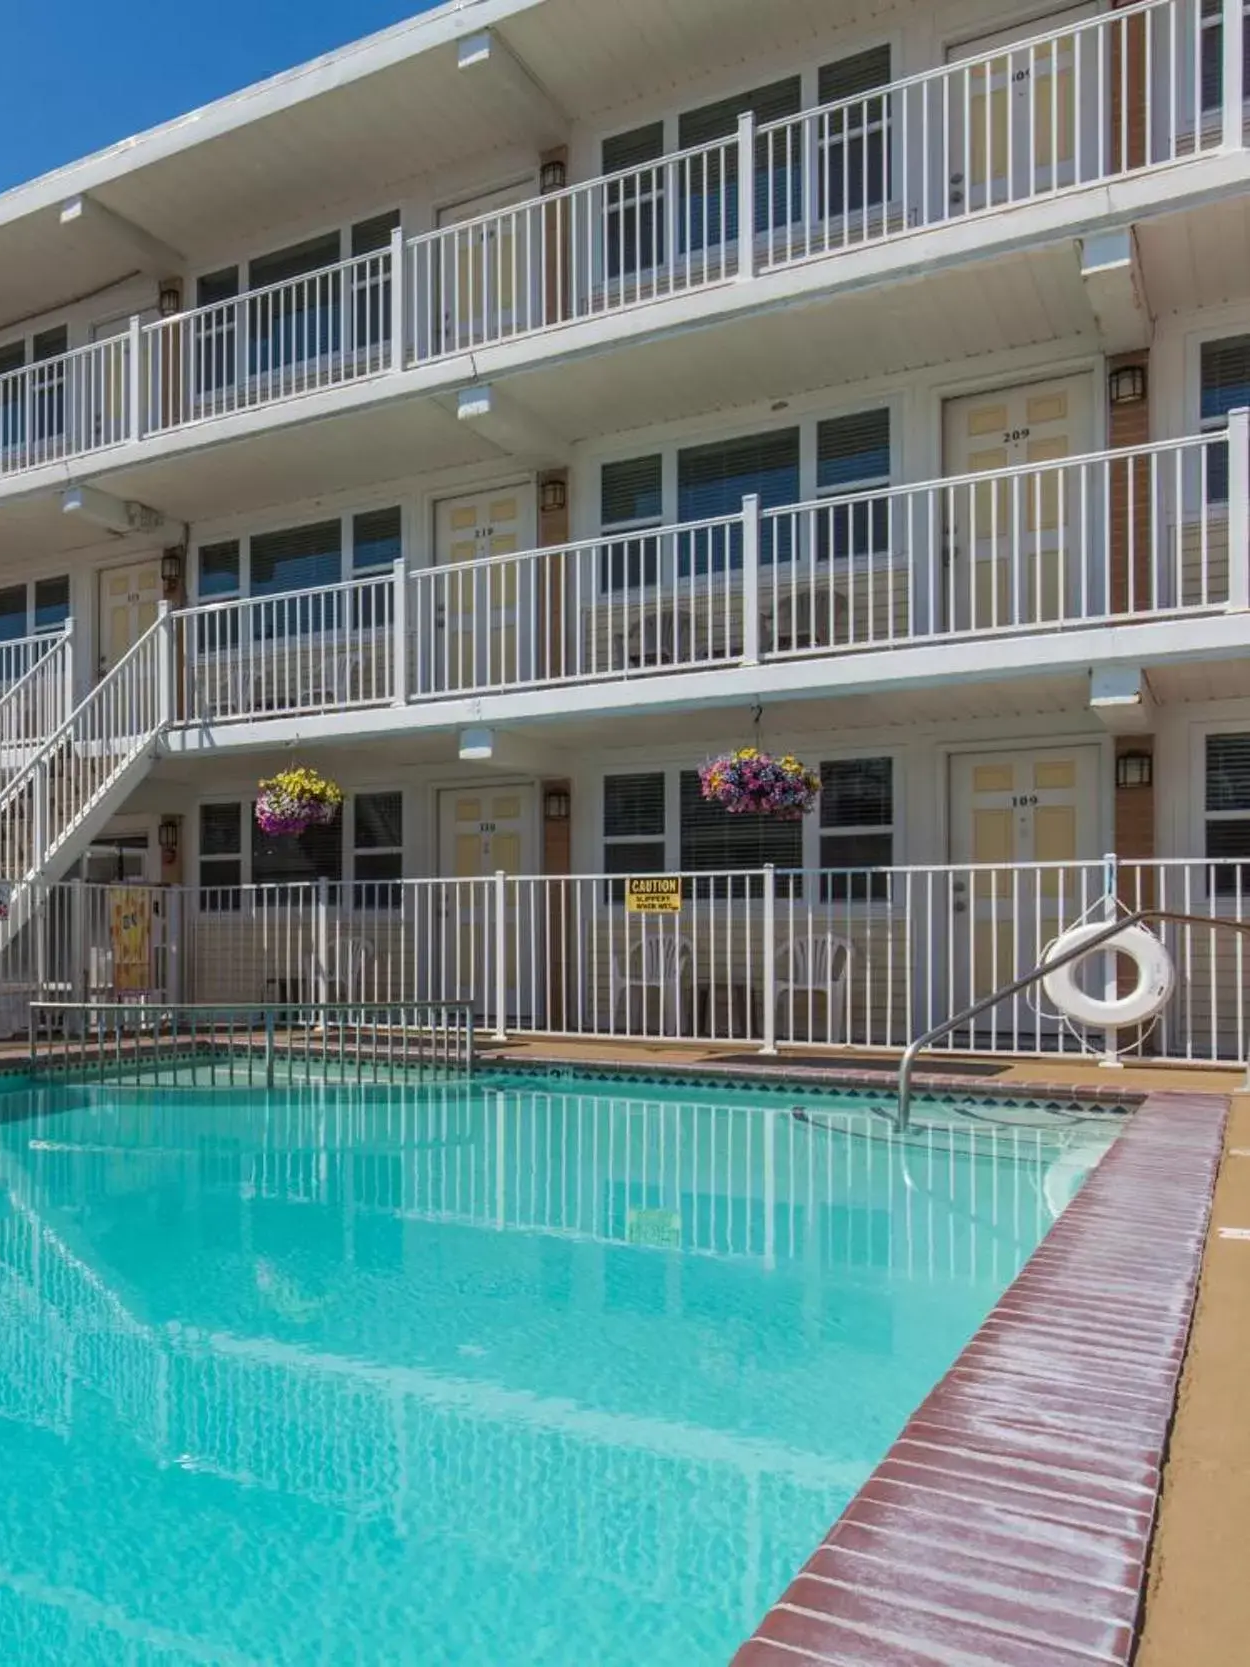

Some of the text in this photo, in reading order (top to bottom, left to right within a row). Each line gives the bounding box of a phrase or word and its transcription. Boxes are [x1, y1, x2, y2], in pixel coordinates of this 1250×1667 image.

[1003, 428, 1030, 443] 209
[1011, 795, 1038, 808] 109
[631, 879, 676, 893] CAUTION
